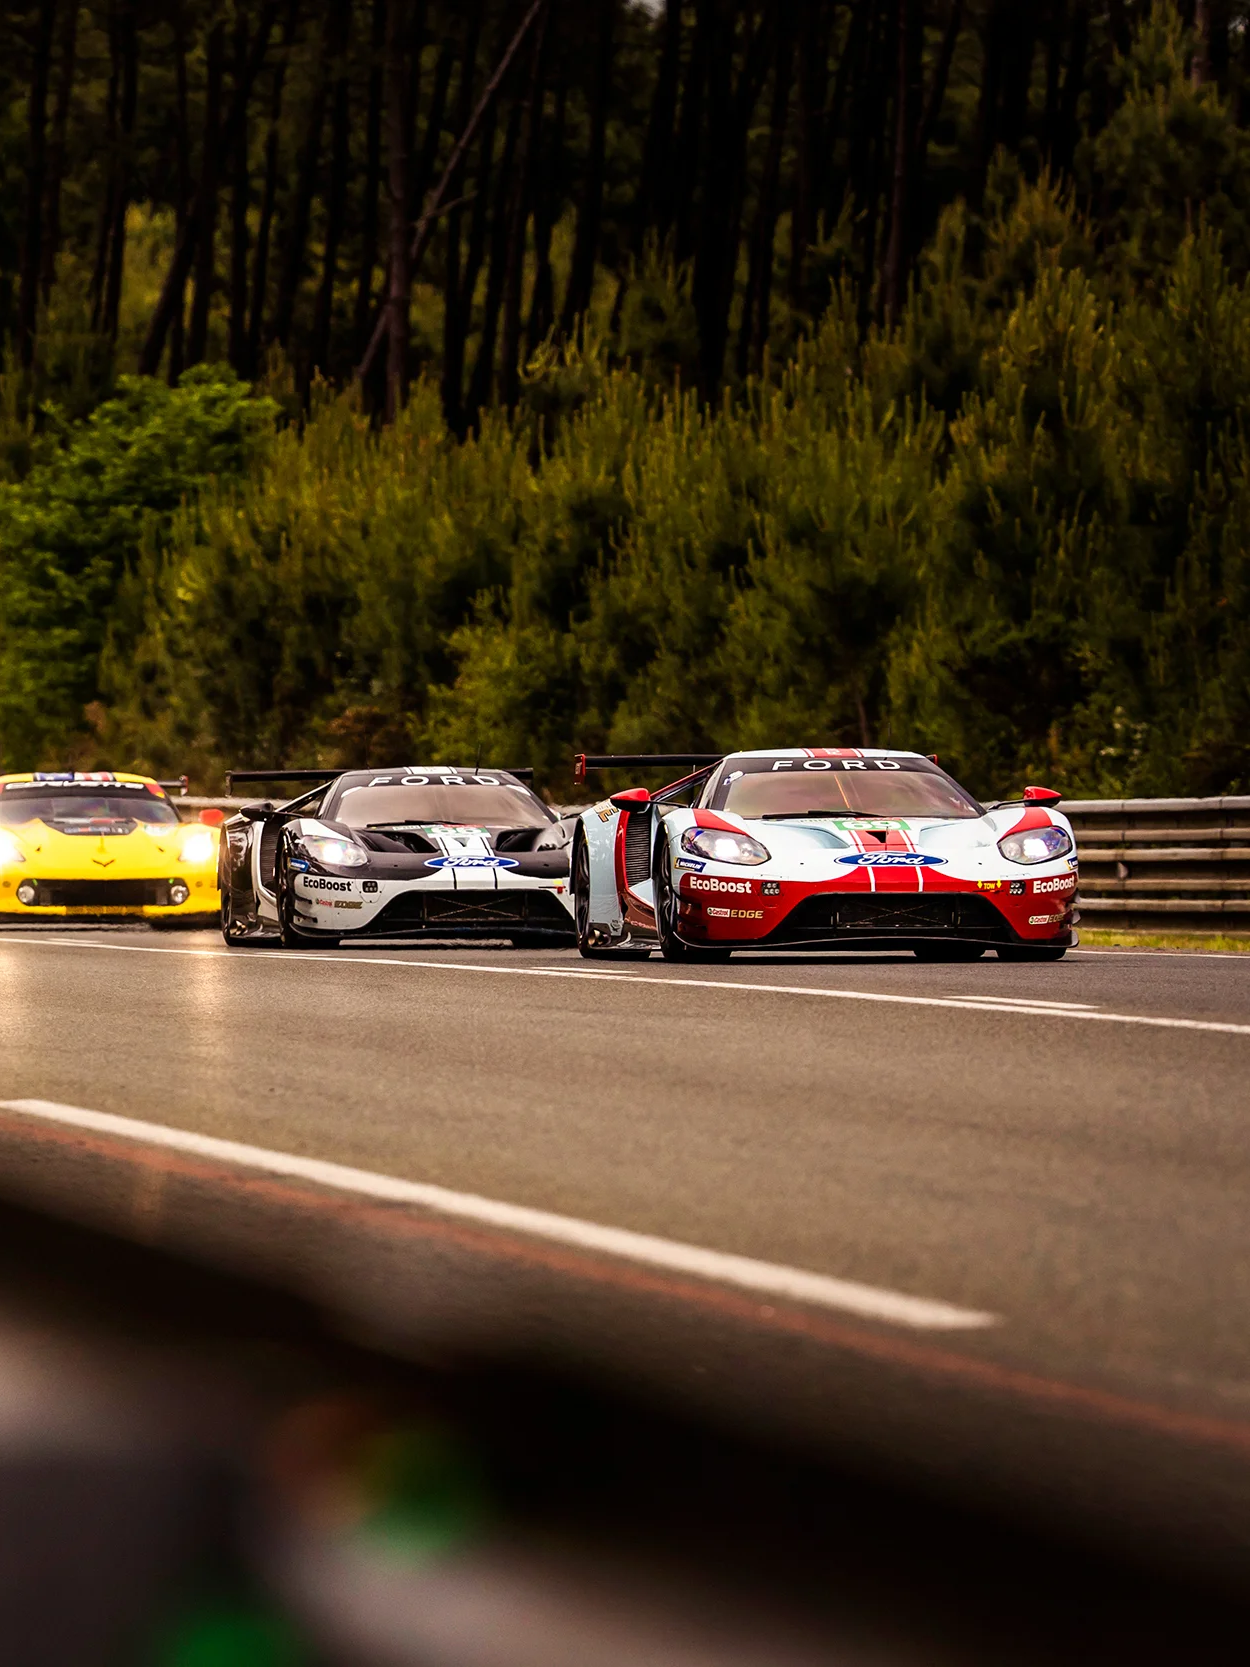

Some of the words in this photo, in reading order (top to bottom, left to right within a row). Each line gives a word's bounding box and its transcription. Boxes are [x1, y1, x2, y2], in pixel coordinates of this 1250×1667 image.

[771, 760, 901, 771] FORD
[368, 775, 500, 787] FORD
[841, 820, 902, 830] 69
[442, 856, 500, 867] Ford
[857, 852, 925, 865] Ford
[303, 876, 352, 892] EcoBoost
[689, 876, 752, 894] EcoBoost
[1033, 875, 1075, 894] EcoBoost
[730, 909, 764, 919] EDGE
